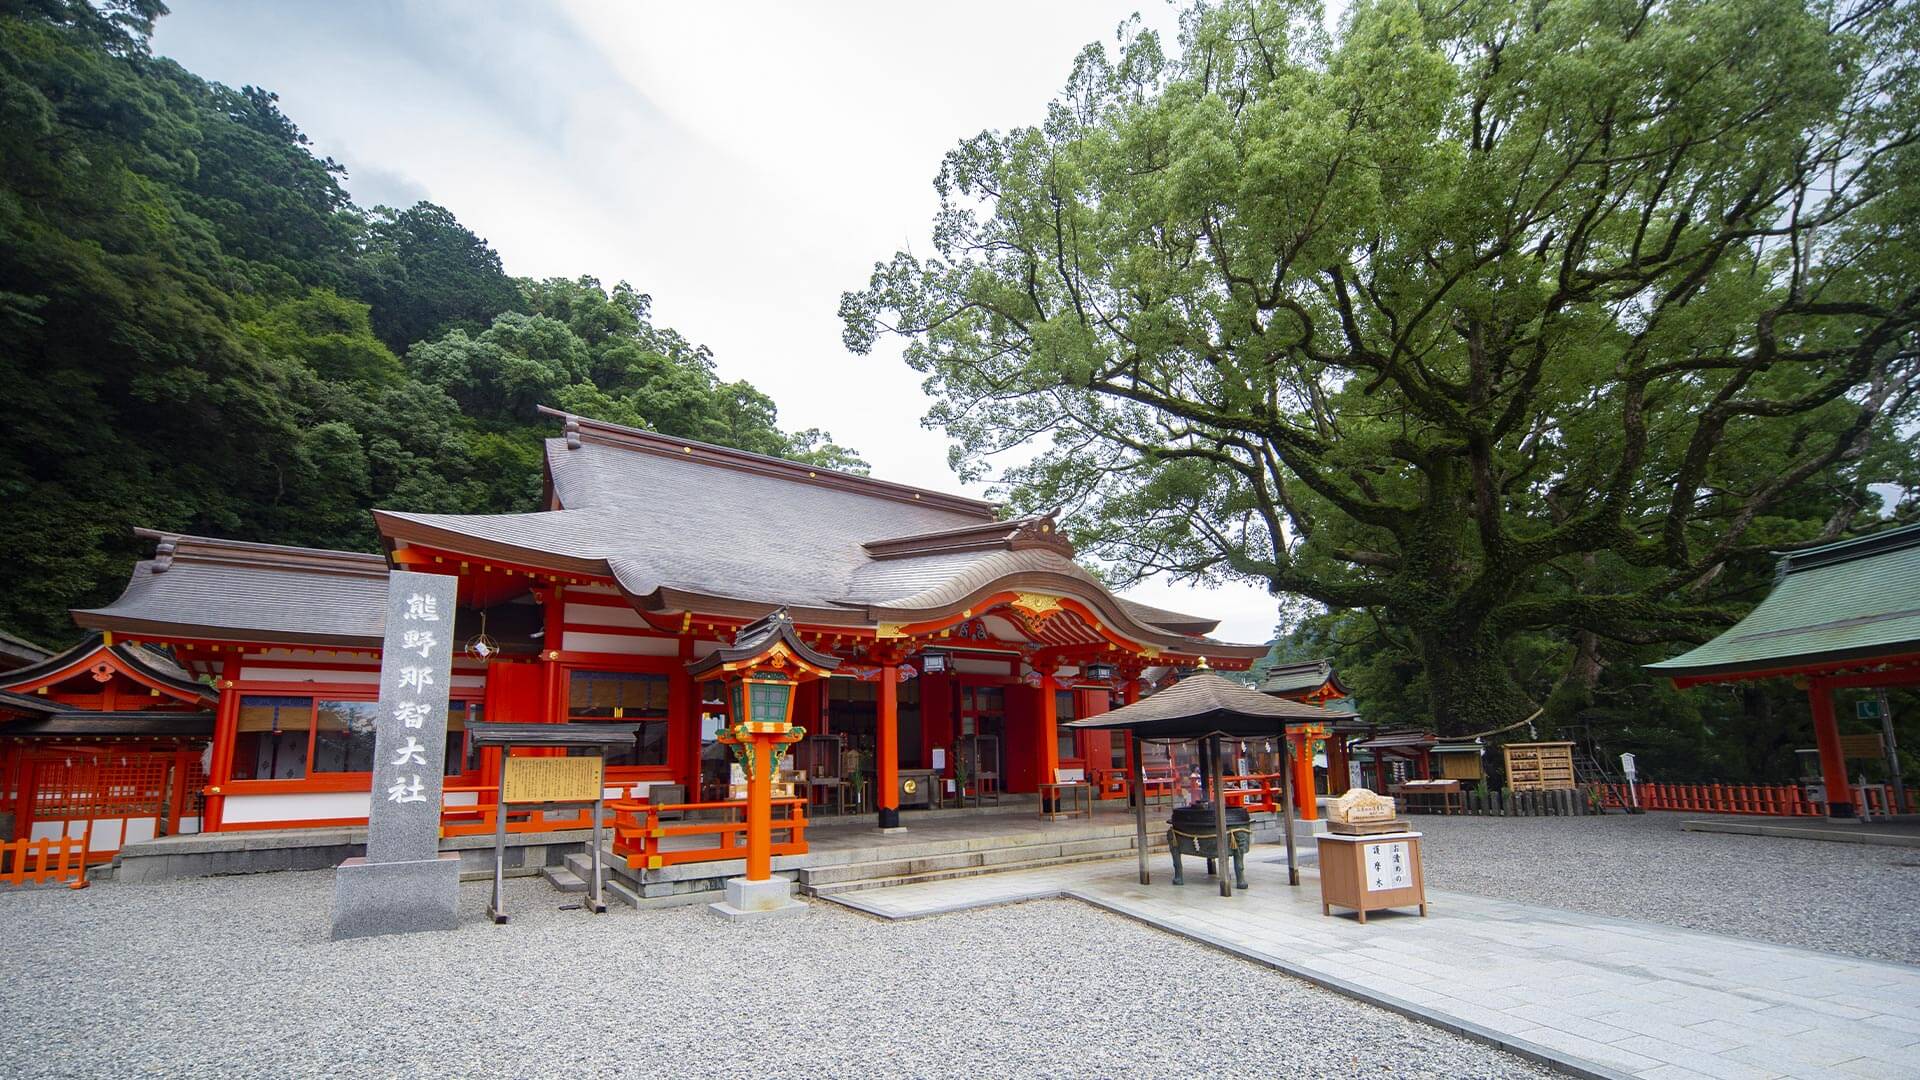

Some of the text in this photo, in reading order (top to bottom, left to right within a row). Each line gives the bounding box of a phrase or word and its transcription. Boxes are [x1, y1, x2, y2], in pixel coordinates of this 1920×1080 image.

[387, 592, 440, 805] 熊野那智大社
